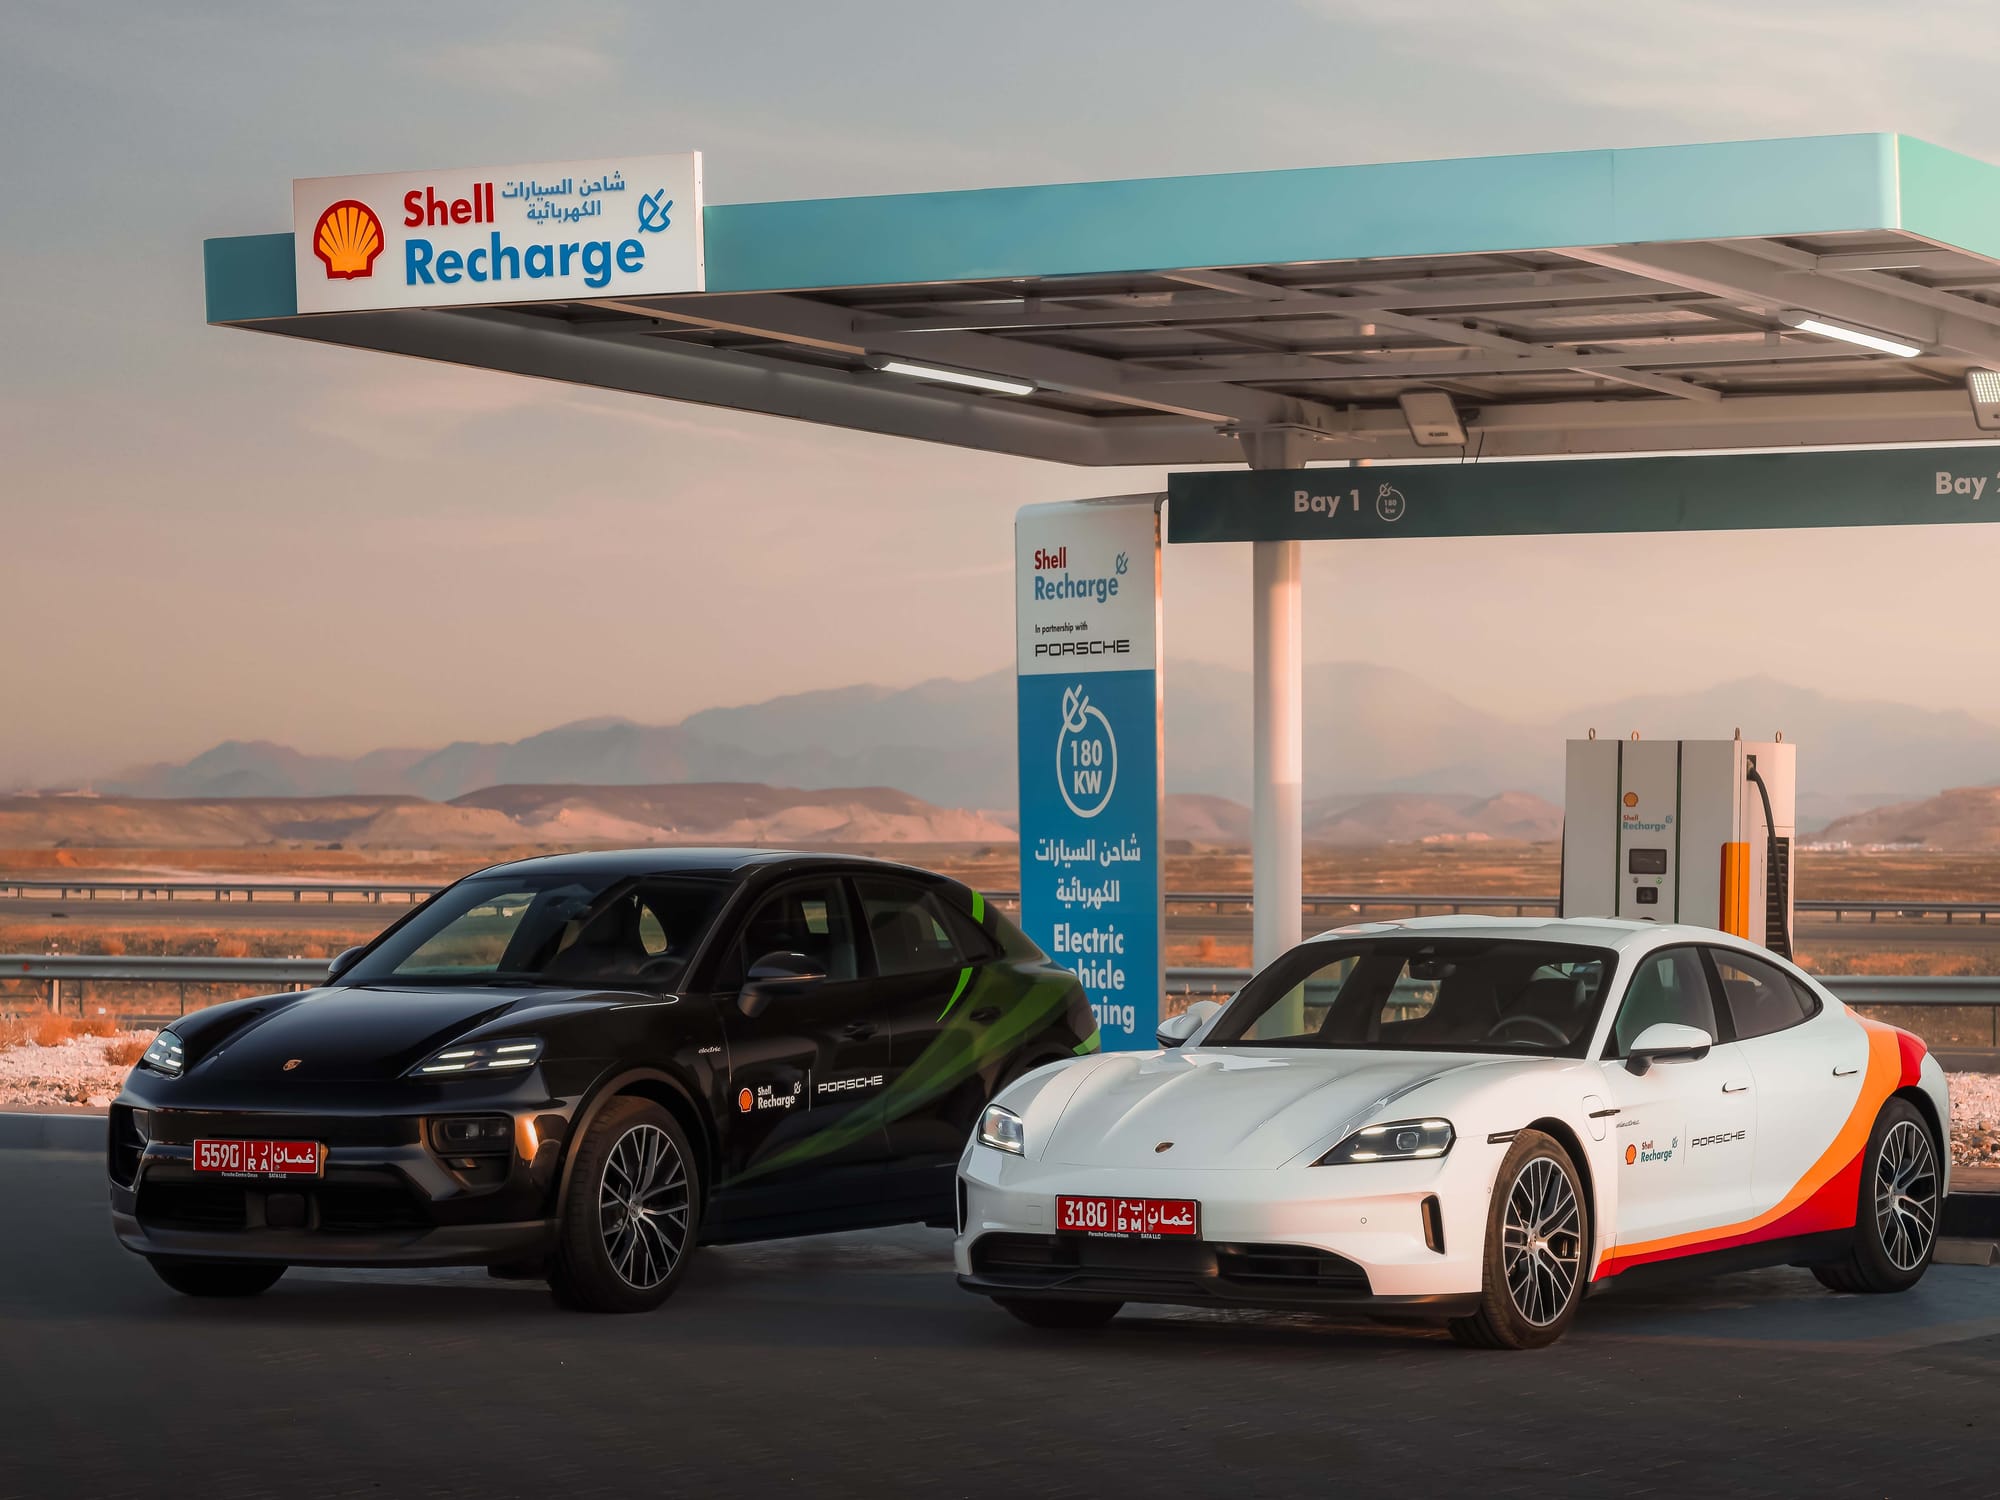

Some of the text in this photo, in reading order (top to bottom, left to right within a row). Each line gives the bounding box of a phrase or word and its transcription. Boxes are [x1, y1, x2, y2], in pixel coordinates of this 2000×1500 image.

[501, 171, 626, 201] شاحن السيارات
[403, 182, 495, 228] Shell
[527, 199, 601, 225] الكهربائية
[405, 232, 645, 289] Recharge
[1936, 471, 1987, 500] Bay
[1294, 489, 1359, 517] Bay 1
[1034, 547, 1067, 570] Shell
[1034, 573, 1119, 603] Recharge
[1035, 621, 1088, 635] In partnership with
[1035, 639, 1130, 657] PORSCHE
[1071, 740, 1103, 767] 180
[1074, 771, 1102, 795] KW
[1623, 821, 1666, 832] Recharge
[1035, 833, 1141, 868] شاحن السيارات
[1056, 876, 1120, 910] الكهربائية
[1053, 922, 1124, 954] Electric
[757, 1085, 772, 1096] Shell
[818, 1075, 883, 1094] PORSCHE
[757, 1094, 795, 1110] Recharge
[1641, 1140, 1654, 1151] Shell
[1692, 1130, 1746, 1148] PORSCHE
[201, 1143, 239, 1168] 5590
[1640, 1149, 1673, 1162] Recharge
[1065, 1201, 1107, 1227] 3180
